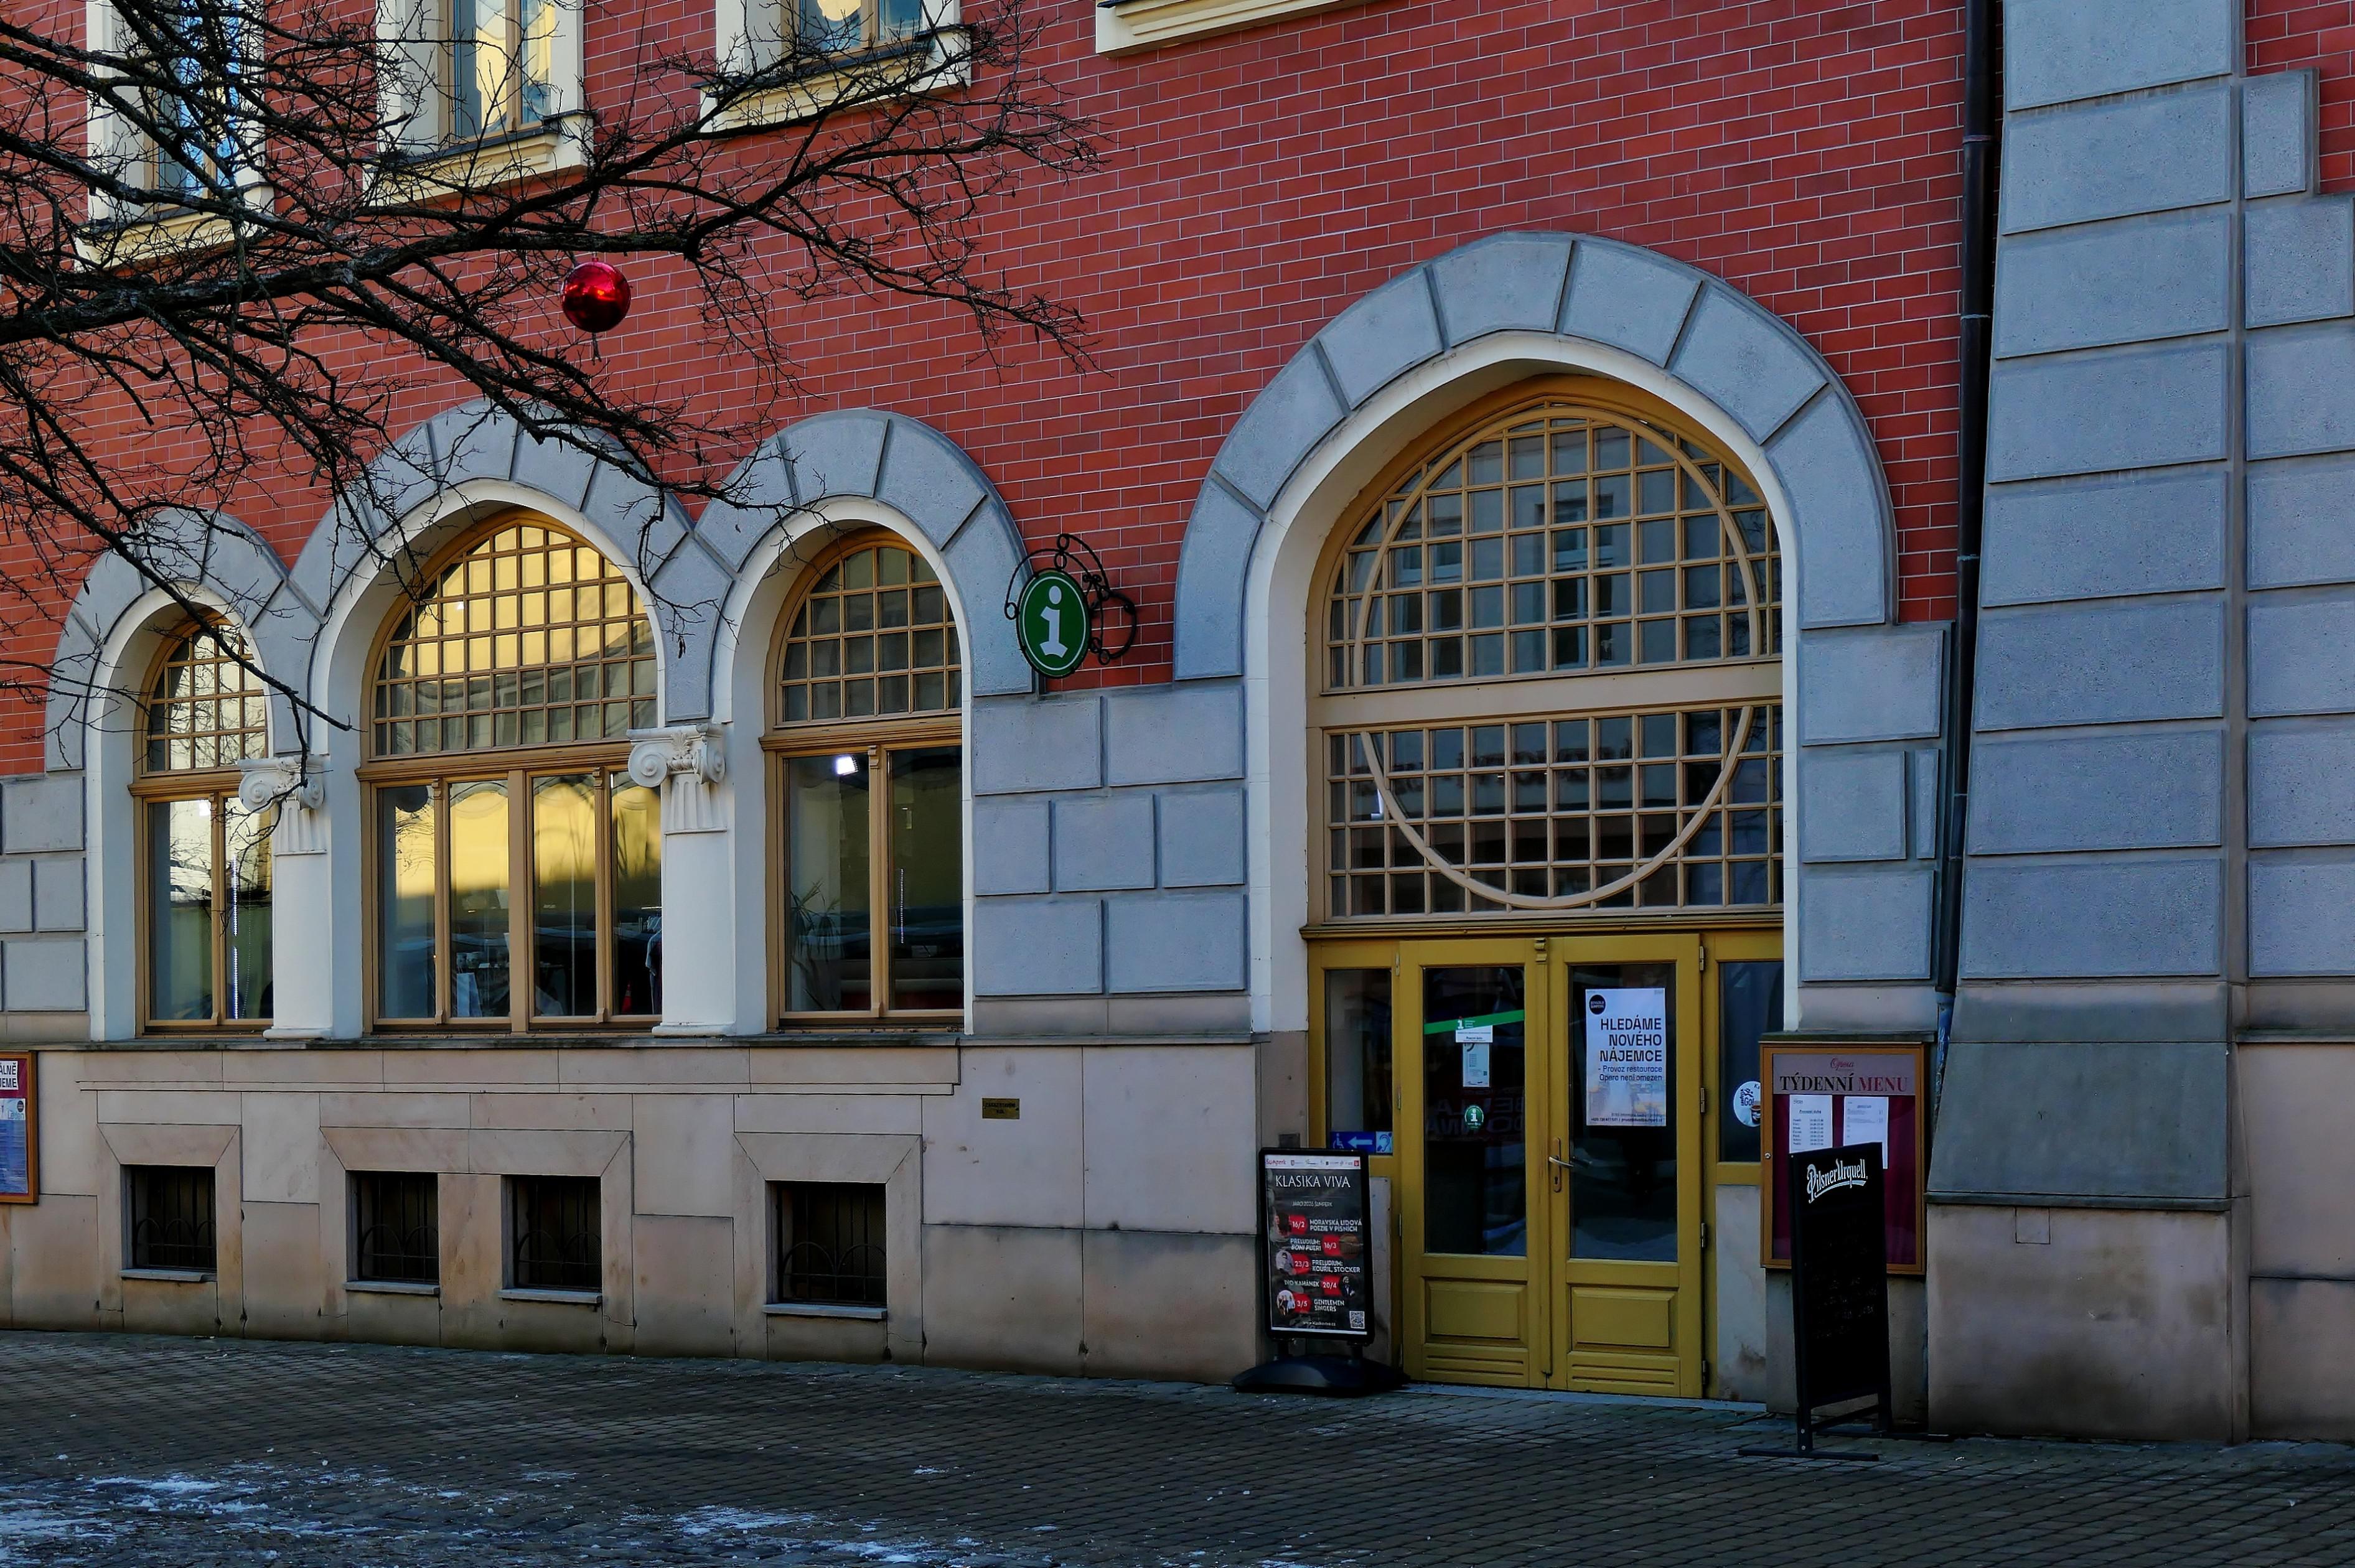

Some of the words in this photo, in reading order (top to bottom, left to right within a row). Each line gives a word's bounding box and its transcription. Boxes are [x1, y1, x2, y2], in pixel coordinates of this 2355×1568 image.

[1600, 1014, 1662, 1030] HLEDÁME
[1608, 1030, 1662, 1046] NOVÉHO
[1599, 1046, 1663, 1062] NÁJEMCE
[1599, 1073, 1619, 1081] Opera
[1779, 1071, 1855, 1091] TÝDENNÍ
[1857, 1076, 1908, 1092] MENU
[1276, 1175, 1321, 1187] KLASIKA
[1324, 1175, 1351, 1188] VIVA
[1807, 1162, 1838, 1203] Pilsner
[1835, 1158, 1866, 1188] Urquell
[1292, 1221, 1305, 1230] 16/2
[1324, 1242, 1337, 1250] 16/3
[1295, 1261, 1309, 1269] 23/3
[1295, 1279, 1319, 1287] KAHÁNEK
[1323, 1282, 1337, 1290] 20/4
[1297, 1300, 1308, 1308] 3/5
